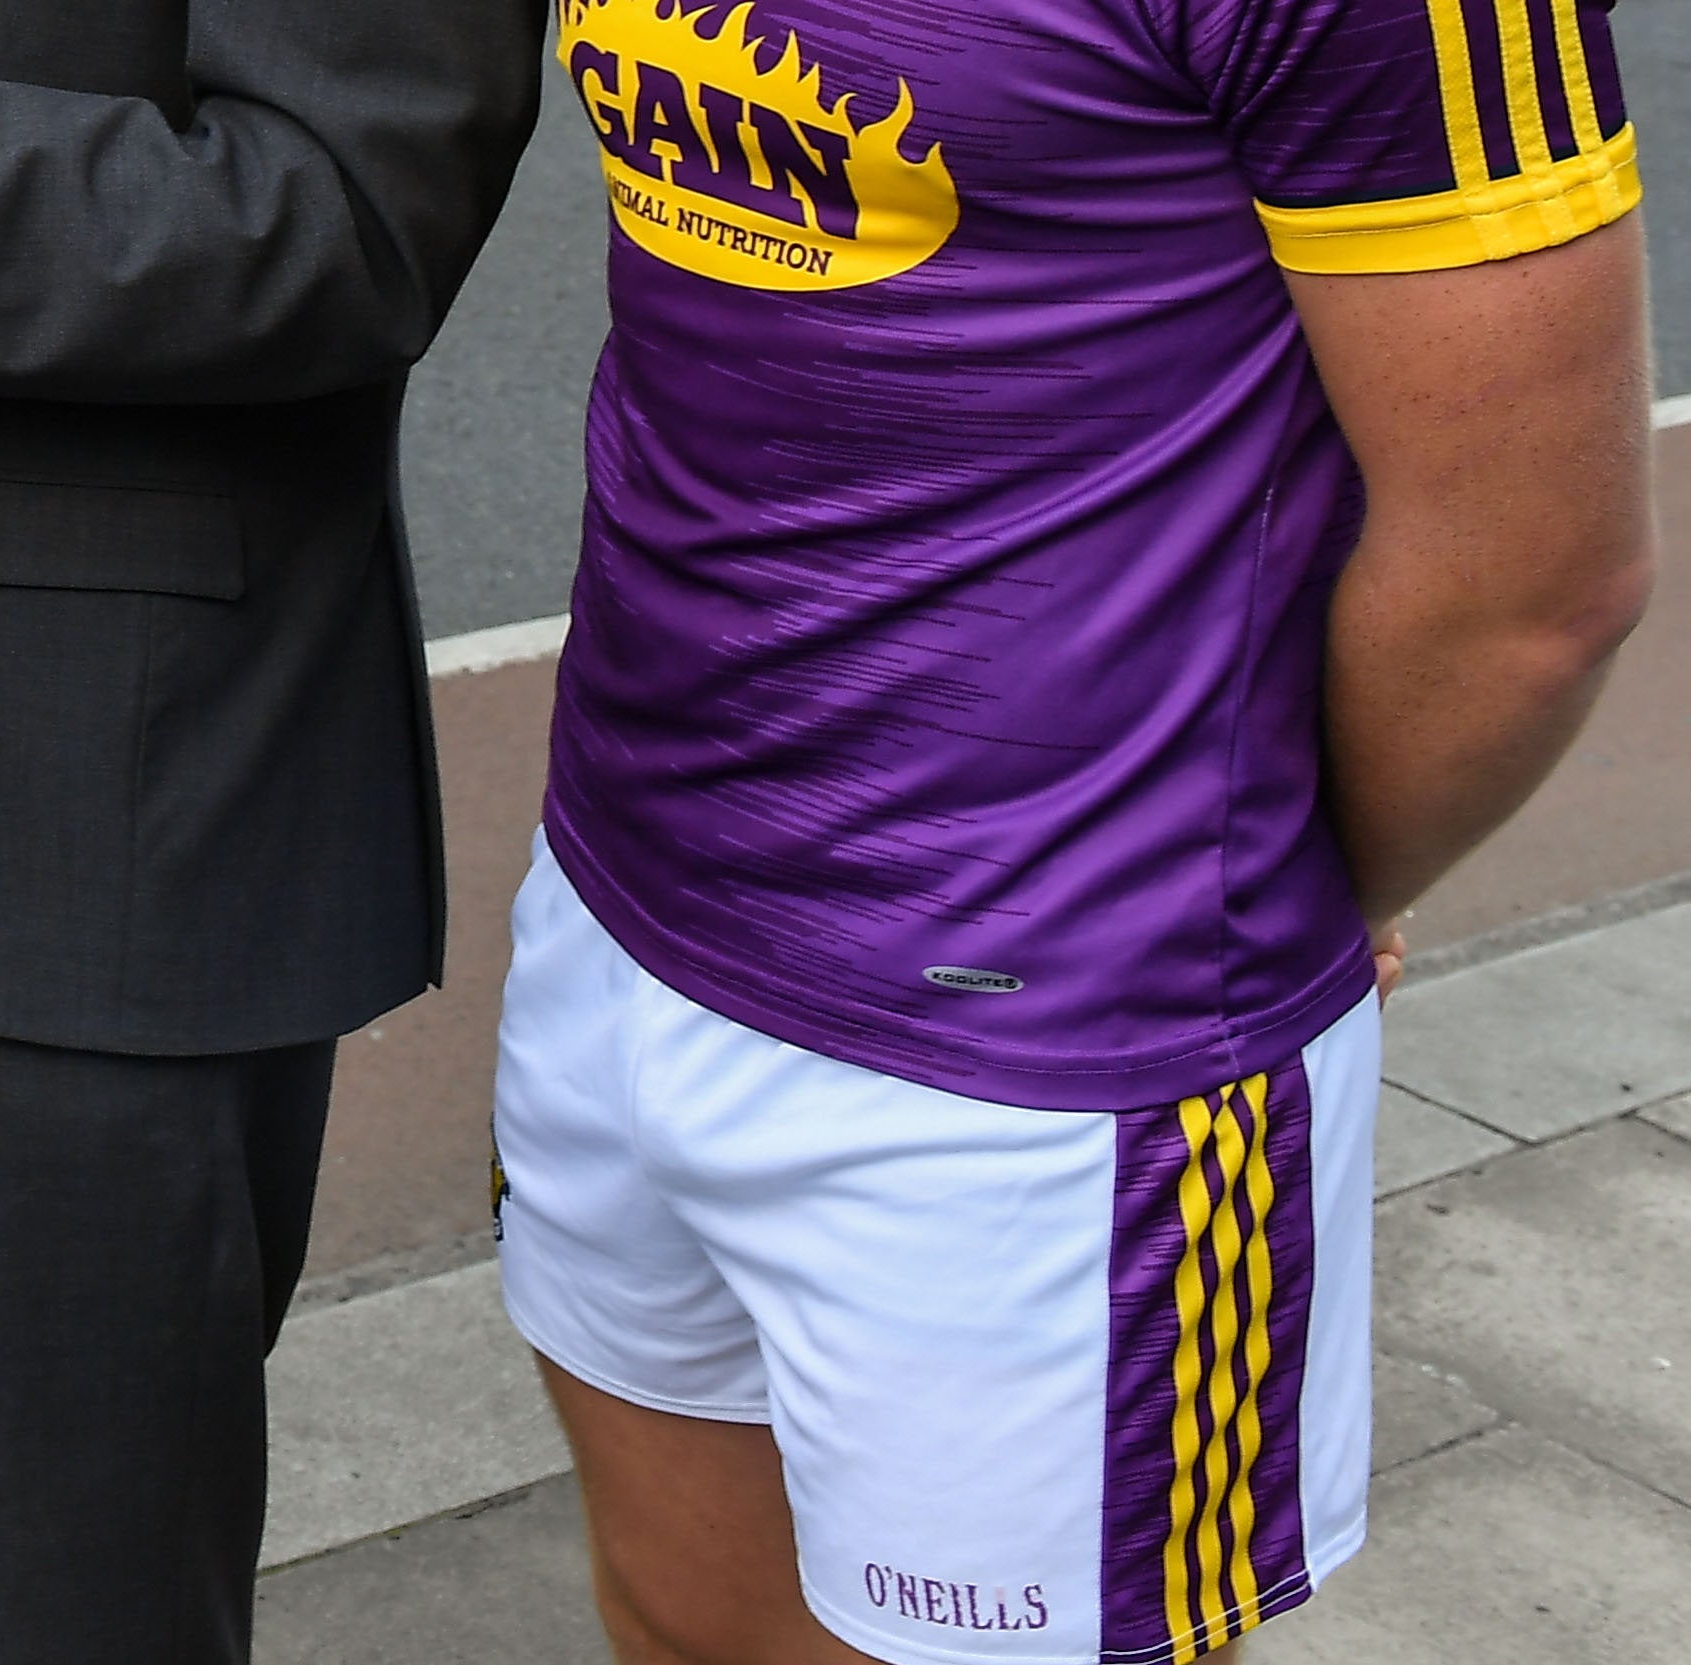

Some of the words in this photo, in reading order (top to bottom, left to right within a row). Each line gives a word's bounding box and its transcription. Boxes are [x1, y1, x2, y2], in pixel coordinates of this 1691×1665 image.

[570, 41, 859, 239] GAIN
[608, 172, 669, 227] NIMAL
[677, 208, 832, 276] NUTRITION
[865, 1563, 1048, 1630] O'NEILLS
